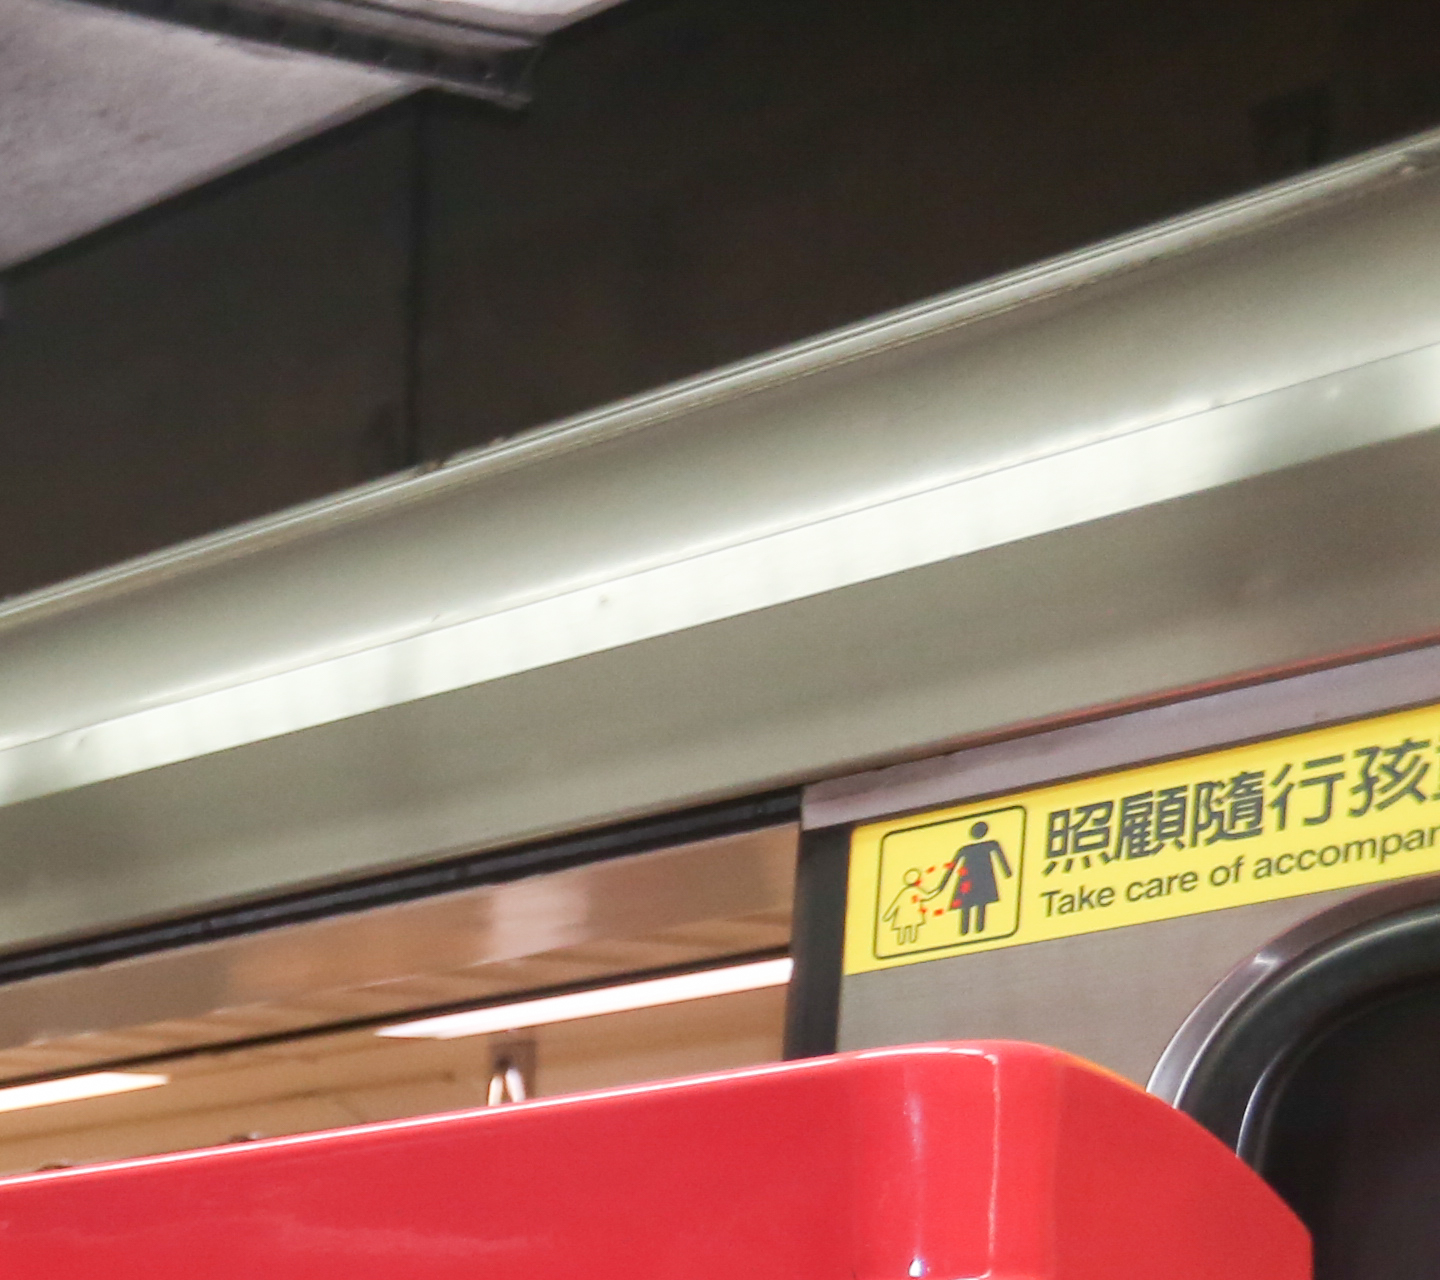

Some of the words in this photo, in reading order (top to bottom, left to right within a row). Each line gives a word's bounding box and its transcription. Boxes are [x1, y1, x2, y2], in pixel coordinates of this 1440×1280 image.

[1041, 737, 1440, 878] 照顧隨行孩
[1040, 884, 1115, 919] Take
[1126, 868, 1198, 903] care
[1209, 855, 1245, 886] of
